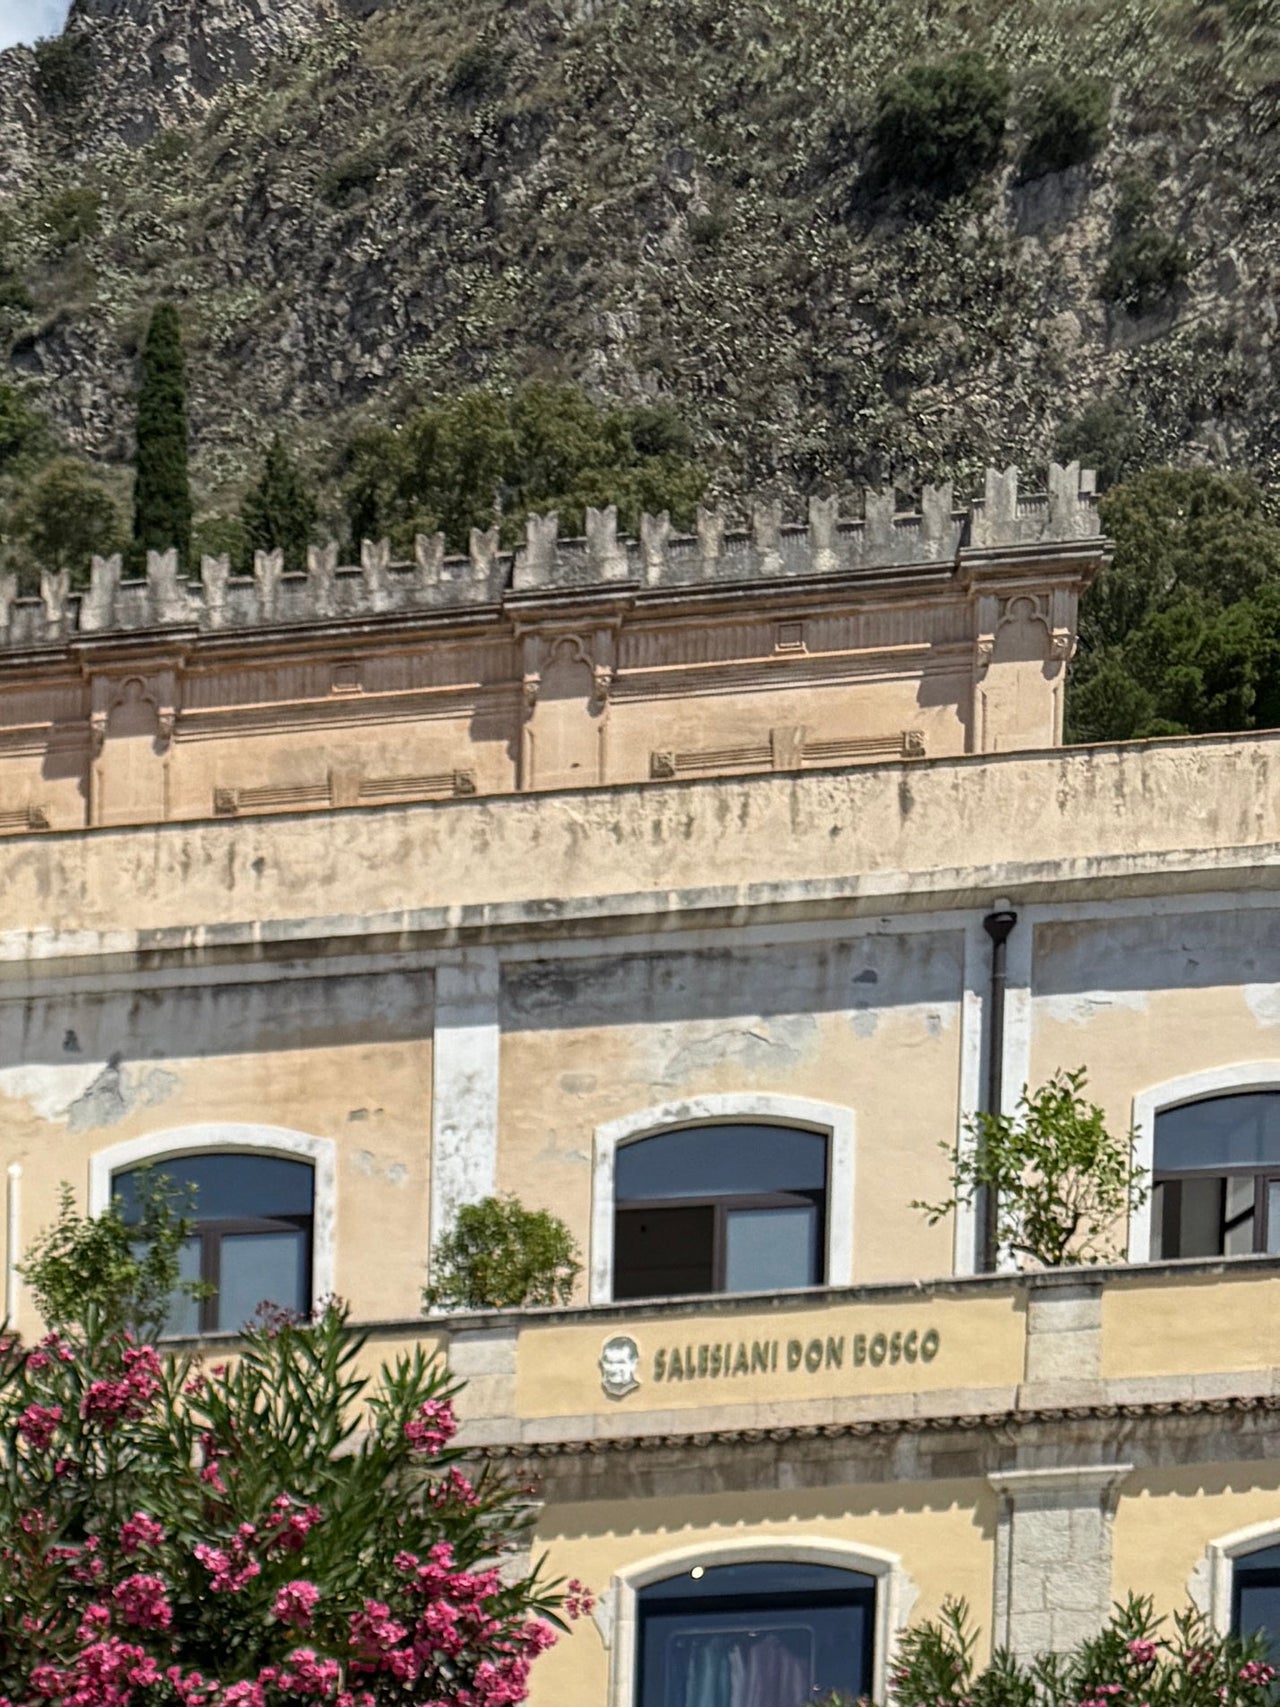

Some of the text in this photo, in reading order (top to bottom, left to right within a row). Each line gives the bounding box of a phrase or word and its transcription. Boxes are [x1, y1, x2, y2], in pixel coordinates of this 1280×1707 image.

[653, 1328, 940, 1383] SALESIANI DON BOSCO
